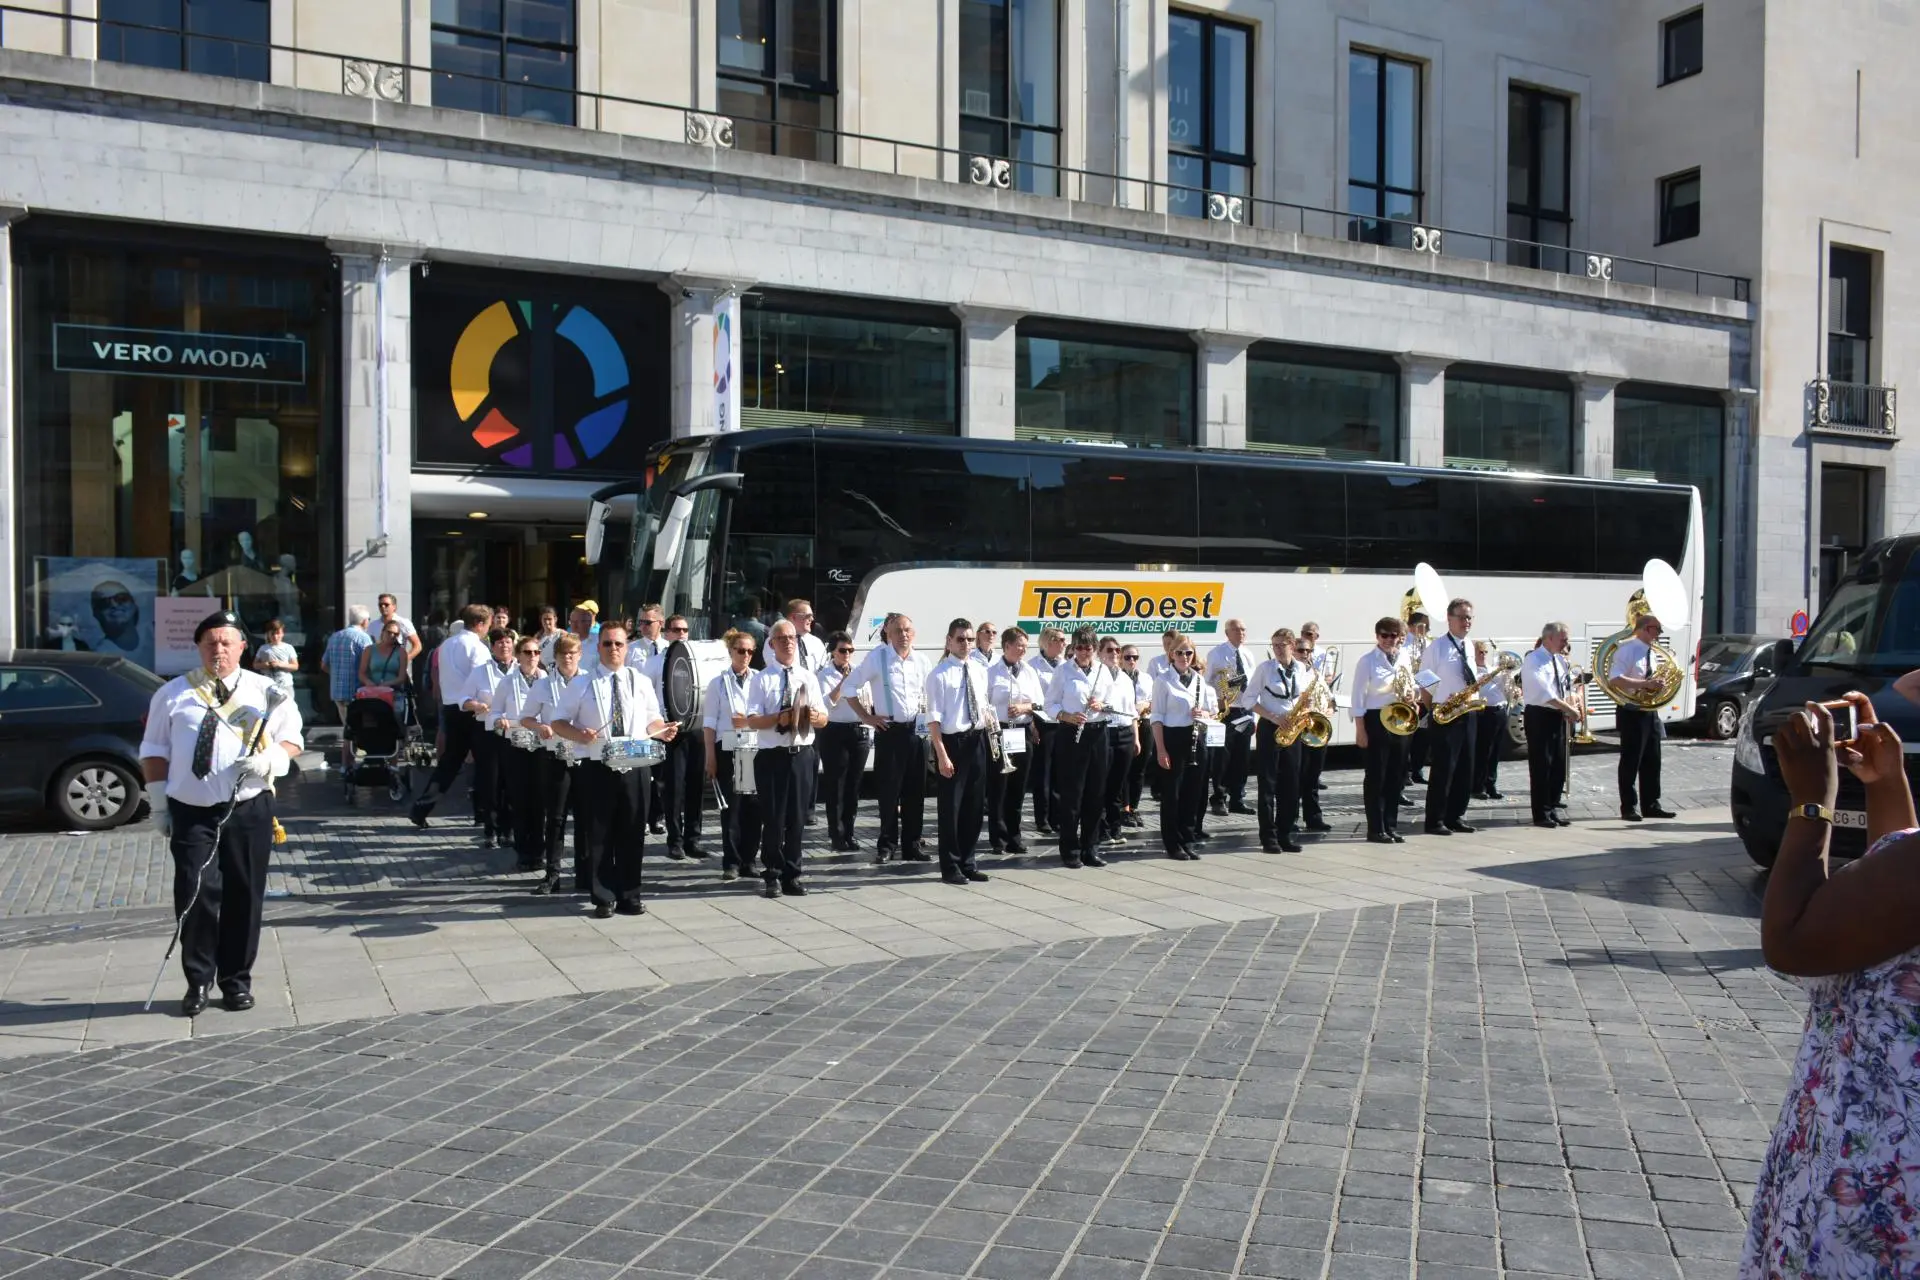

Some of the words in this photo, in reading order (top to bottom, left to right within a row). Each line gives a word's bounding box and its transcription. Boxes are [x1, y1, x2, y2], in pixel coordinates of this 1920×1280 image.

[93, 341, 173, 363] VERO
[181, 348, 267, 368] MODA
[1034, 587, 1091, 618] Ter
[1104, 587, 1213, 618] Doest
[1123, 621, 1196, 632] HENGEVELDE
